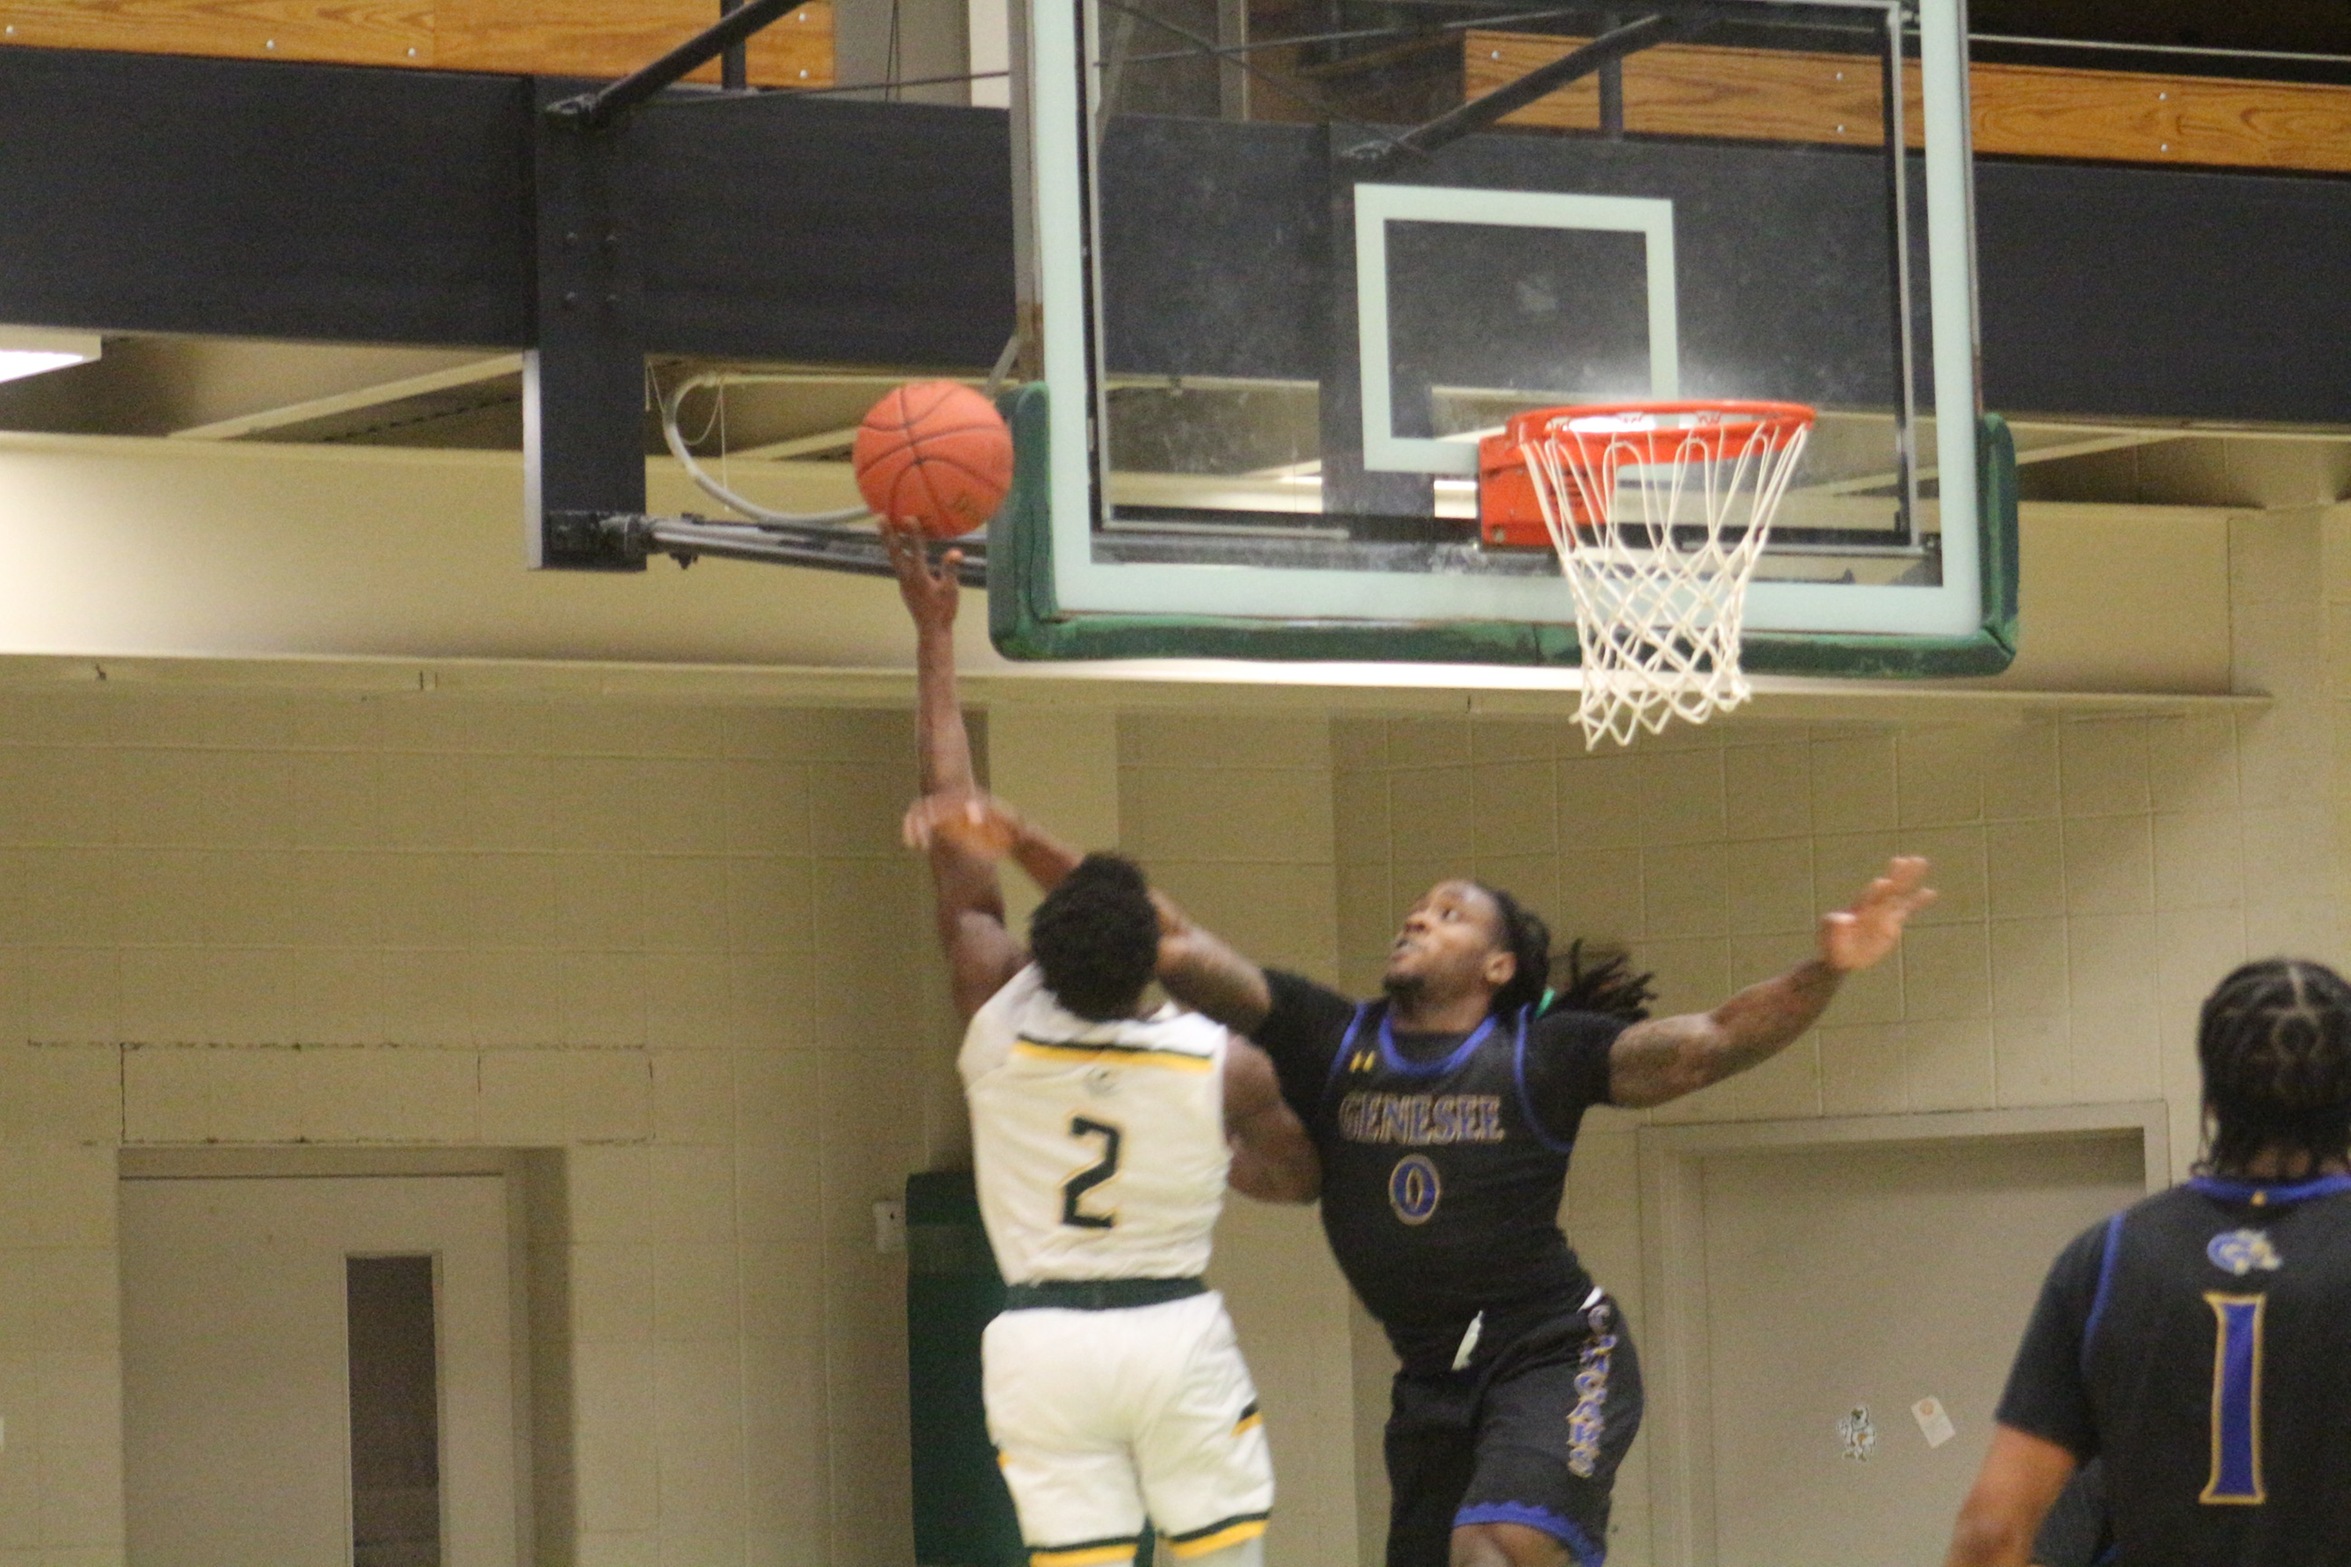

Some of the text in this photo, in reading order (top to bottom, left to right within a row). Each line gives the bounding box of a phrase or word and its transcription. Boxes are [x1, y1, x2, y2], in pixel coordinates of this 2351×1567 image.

[1339, 1091, 1505, 1145] GENESEE
[1059, 1113, 1122, 1230] 2
[1388, 1153, 1441, 1226] 0
[2199, 1291, 2267, 1505] 1
